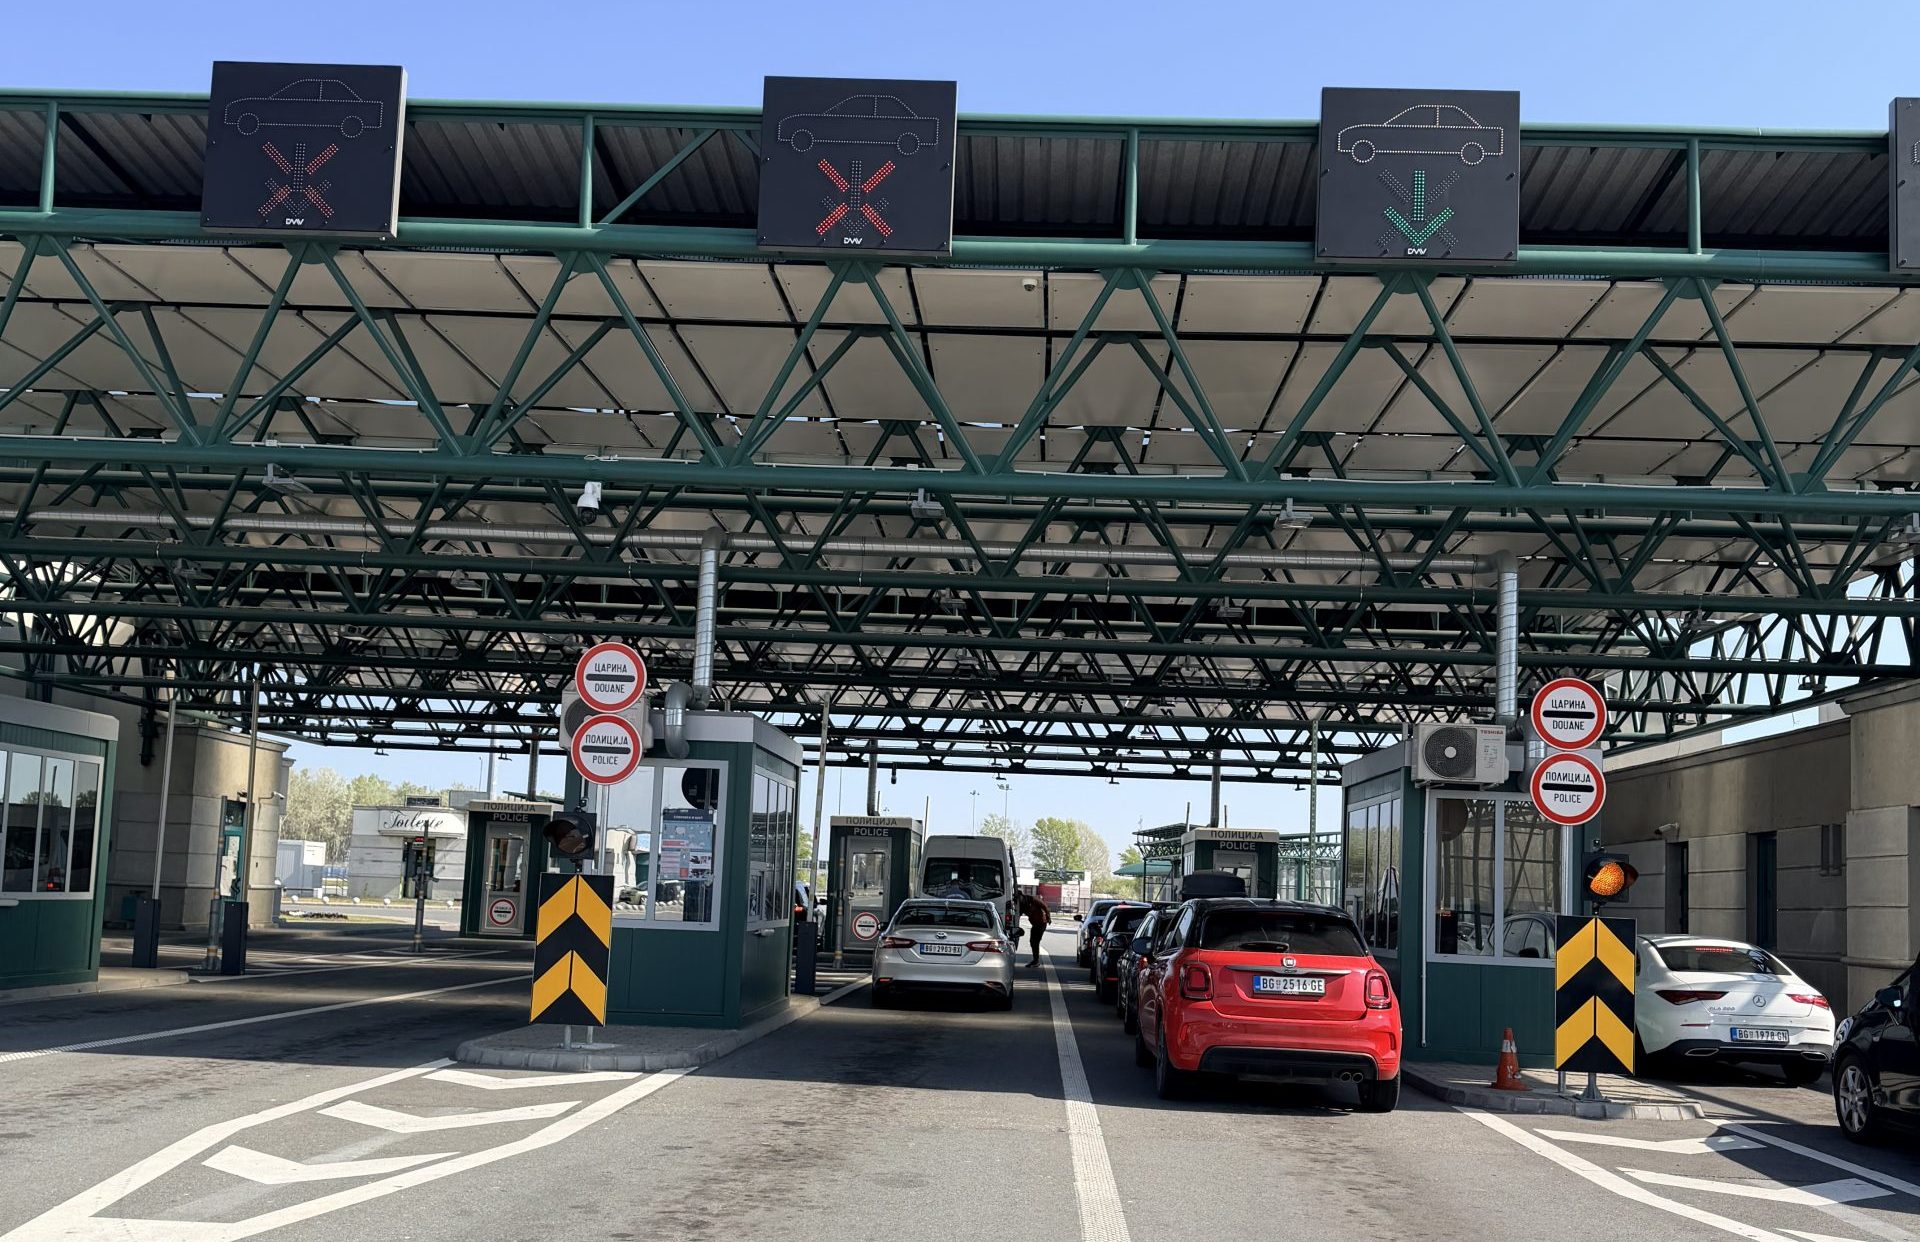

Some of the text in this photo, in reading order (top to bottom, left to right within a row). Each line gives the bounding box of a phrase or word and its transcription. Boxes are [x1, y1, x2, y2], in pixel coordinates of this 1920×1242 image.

[594, 662, 628, 673] ЦАРИНА
[594, 683, 625, 693] DOUANE
[1551, 699, 1586, 709] ЦАРИНА
[1552, 720, 1585, 730] DOUANE
[585, 734, 629, 746] ПОЛИЦИЈА
[592, 755, 619, 765] POLICE
[1545, 771, 1592, 783] ПОЛИЦИЈА
[1553, 793, 1582, 803] POLICE
[483, 802, 536, 812] ПОЛИЦИЈА
[493, 813, 529, 822] POLICE
[846, 817, 898, 826] ПОЛИЦИЈА
[853, 827, 889, 837] POLICE
[1210, 830, 1264, 840] ПОЛИЦИЈА
[1220, 841, 1256, 850] POLICE
[1262, 978, 1275, 989] BG
[1738, 1029, 1749, 1039] BG
